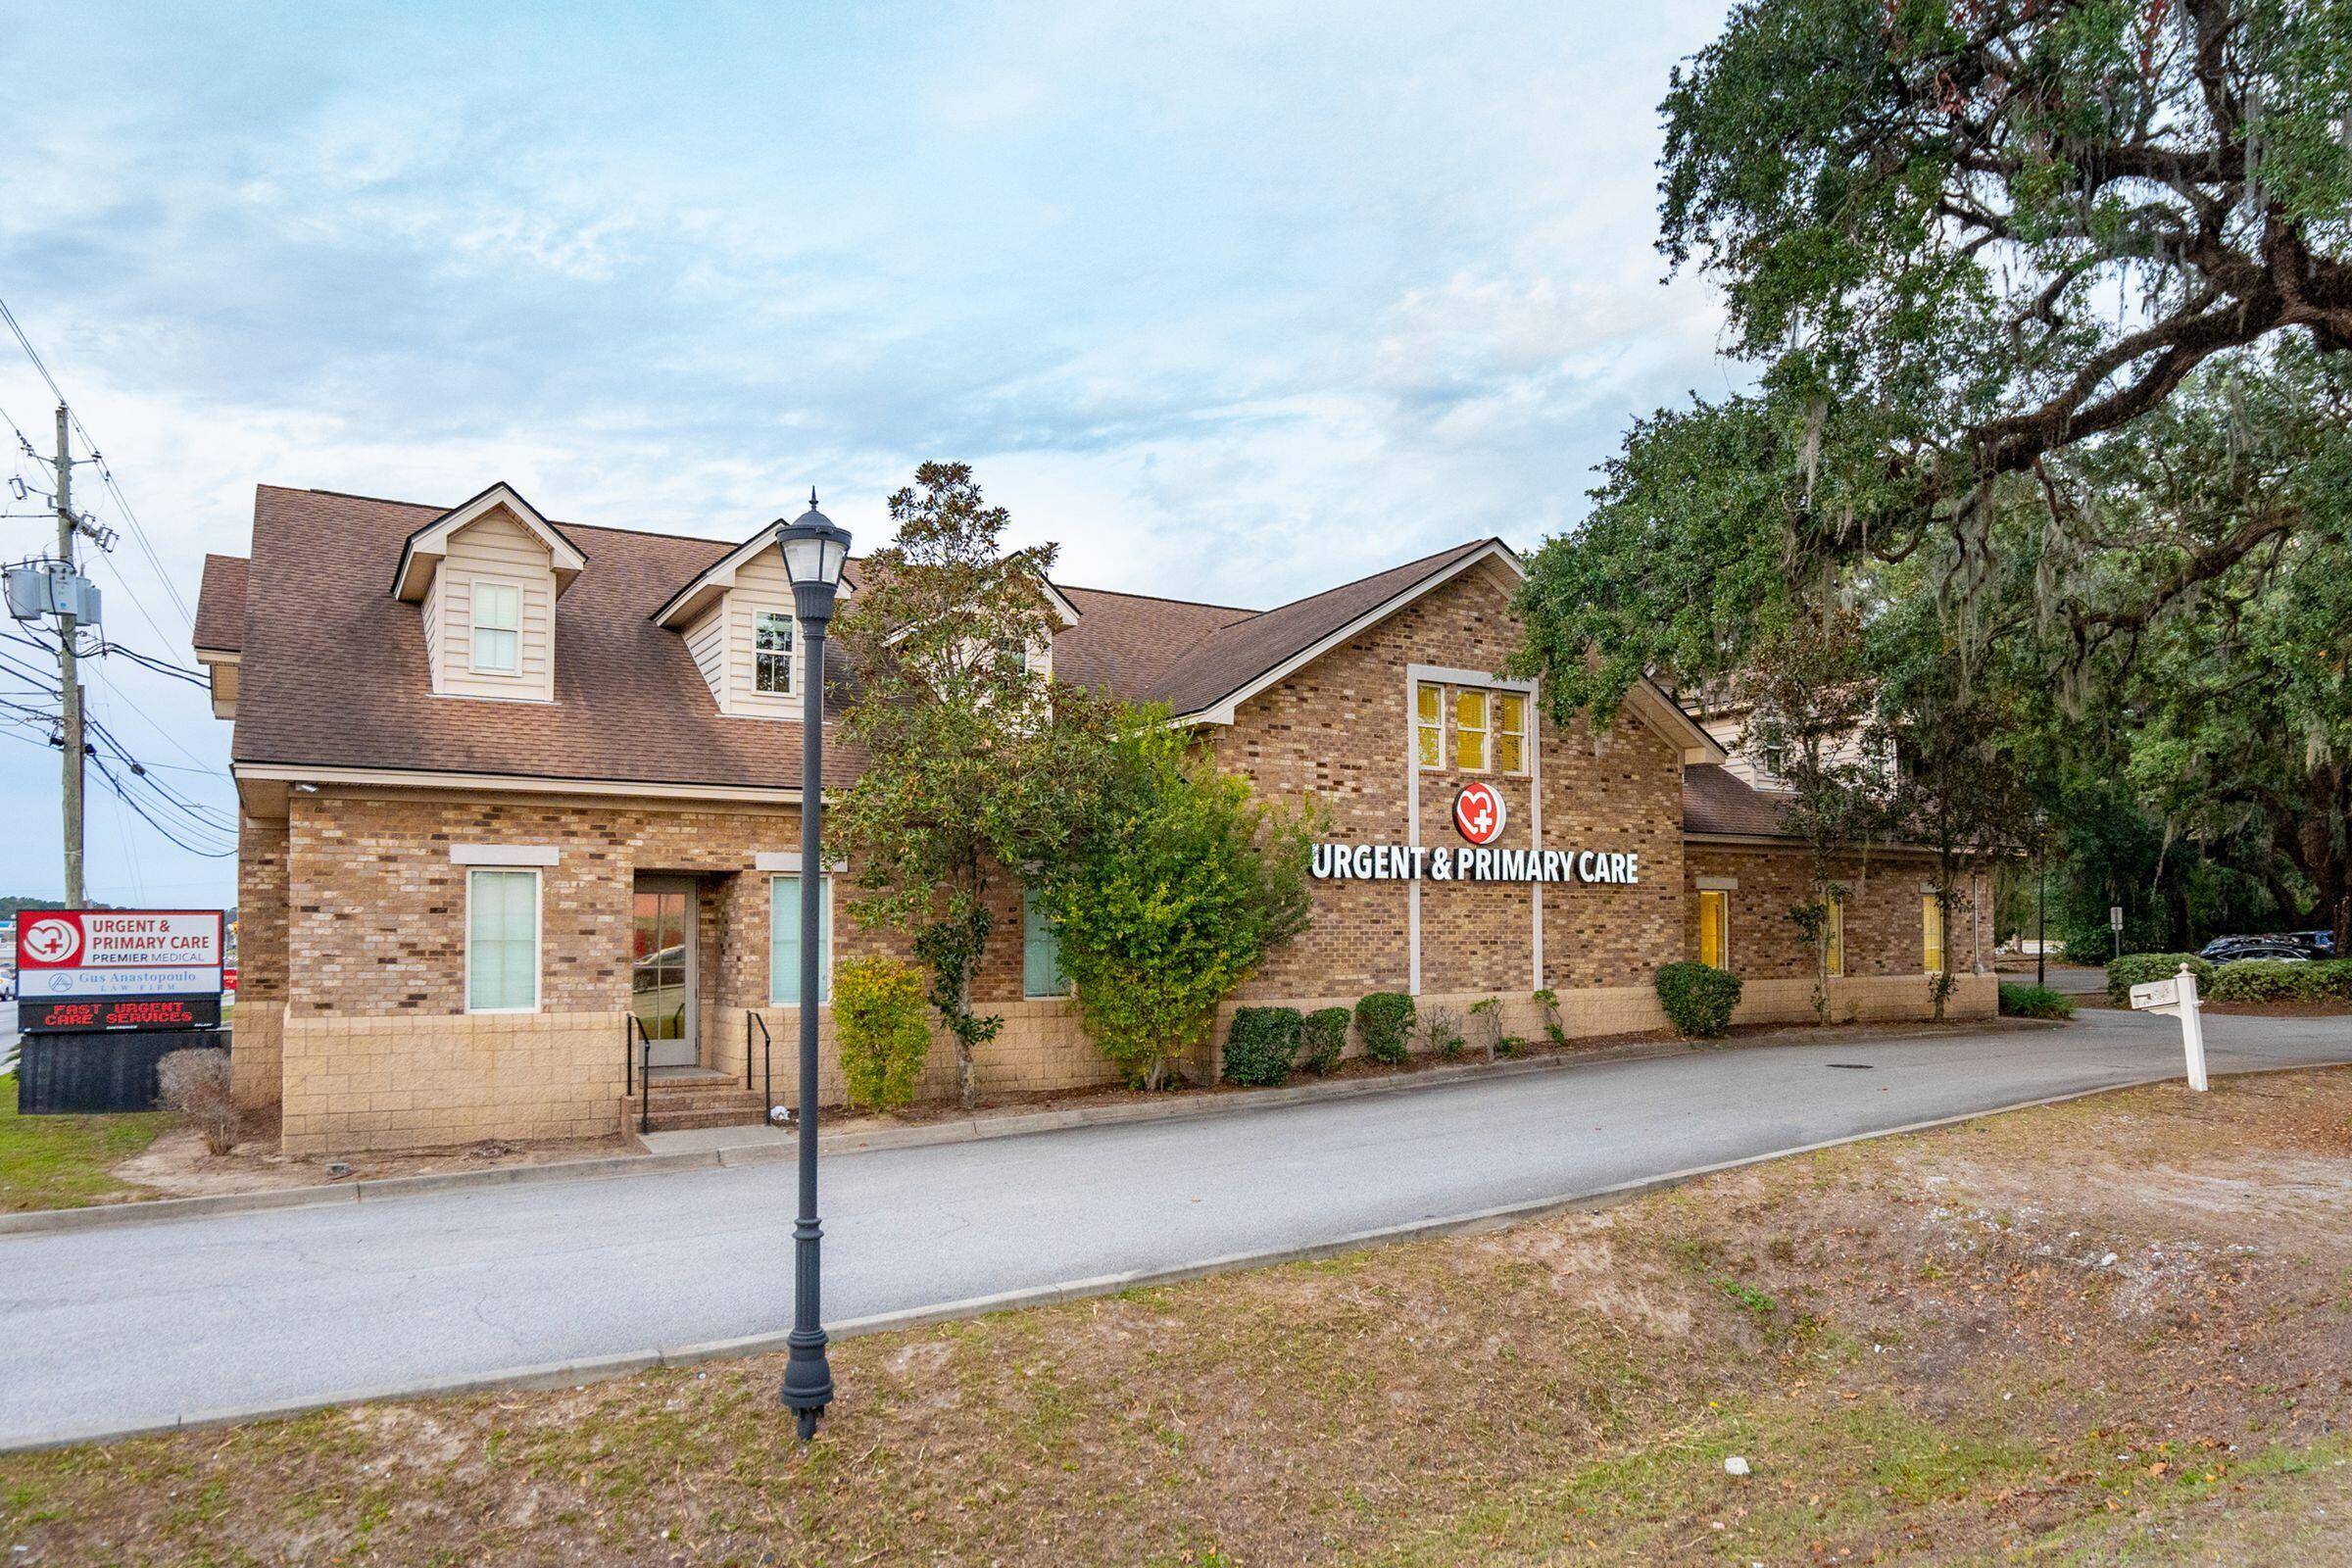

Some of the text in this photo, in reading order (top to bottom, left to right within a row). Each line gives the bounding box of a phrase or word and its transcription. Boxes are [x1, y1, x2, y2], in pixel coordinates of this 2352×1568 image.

[1311, 843, 1639, 884] URGENT & PRIMARY CARE
[92, 919, 171, 933] URGENT &
[92, 936, 210, 950] PRIMARY CARE
[92, 953, 205, 962] PREMIER MEDICAL
[79, 970, 196, 984] Gus Anastopoulo
[52, 1002, 184, 1015] FAST URGENT
[44, 1010, 193, 1026] CARE SERVICES
